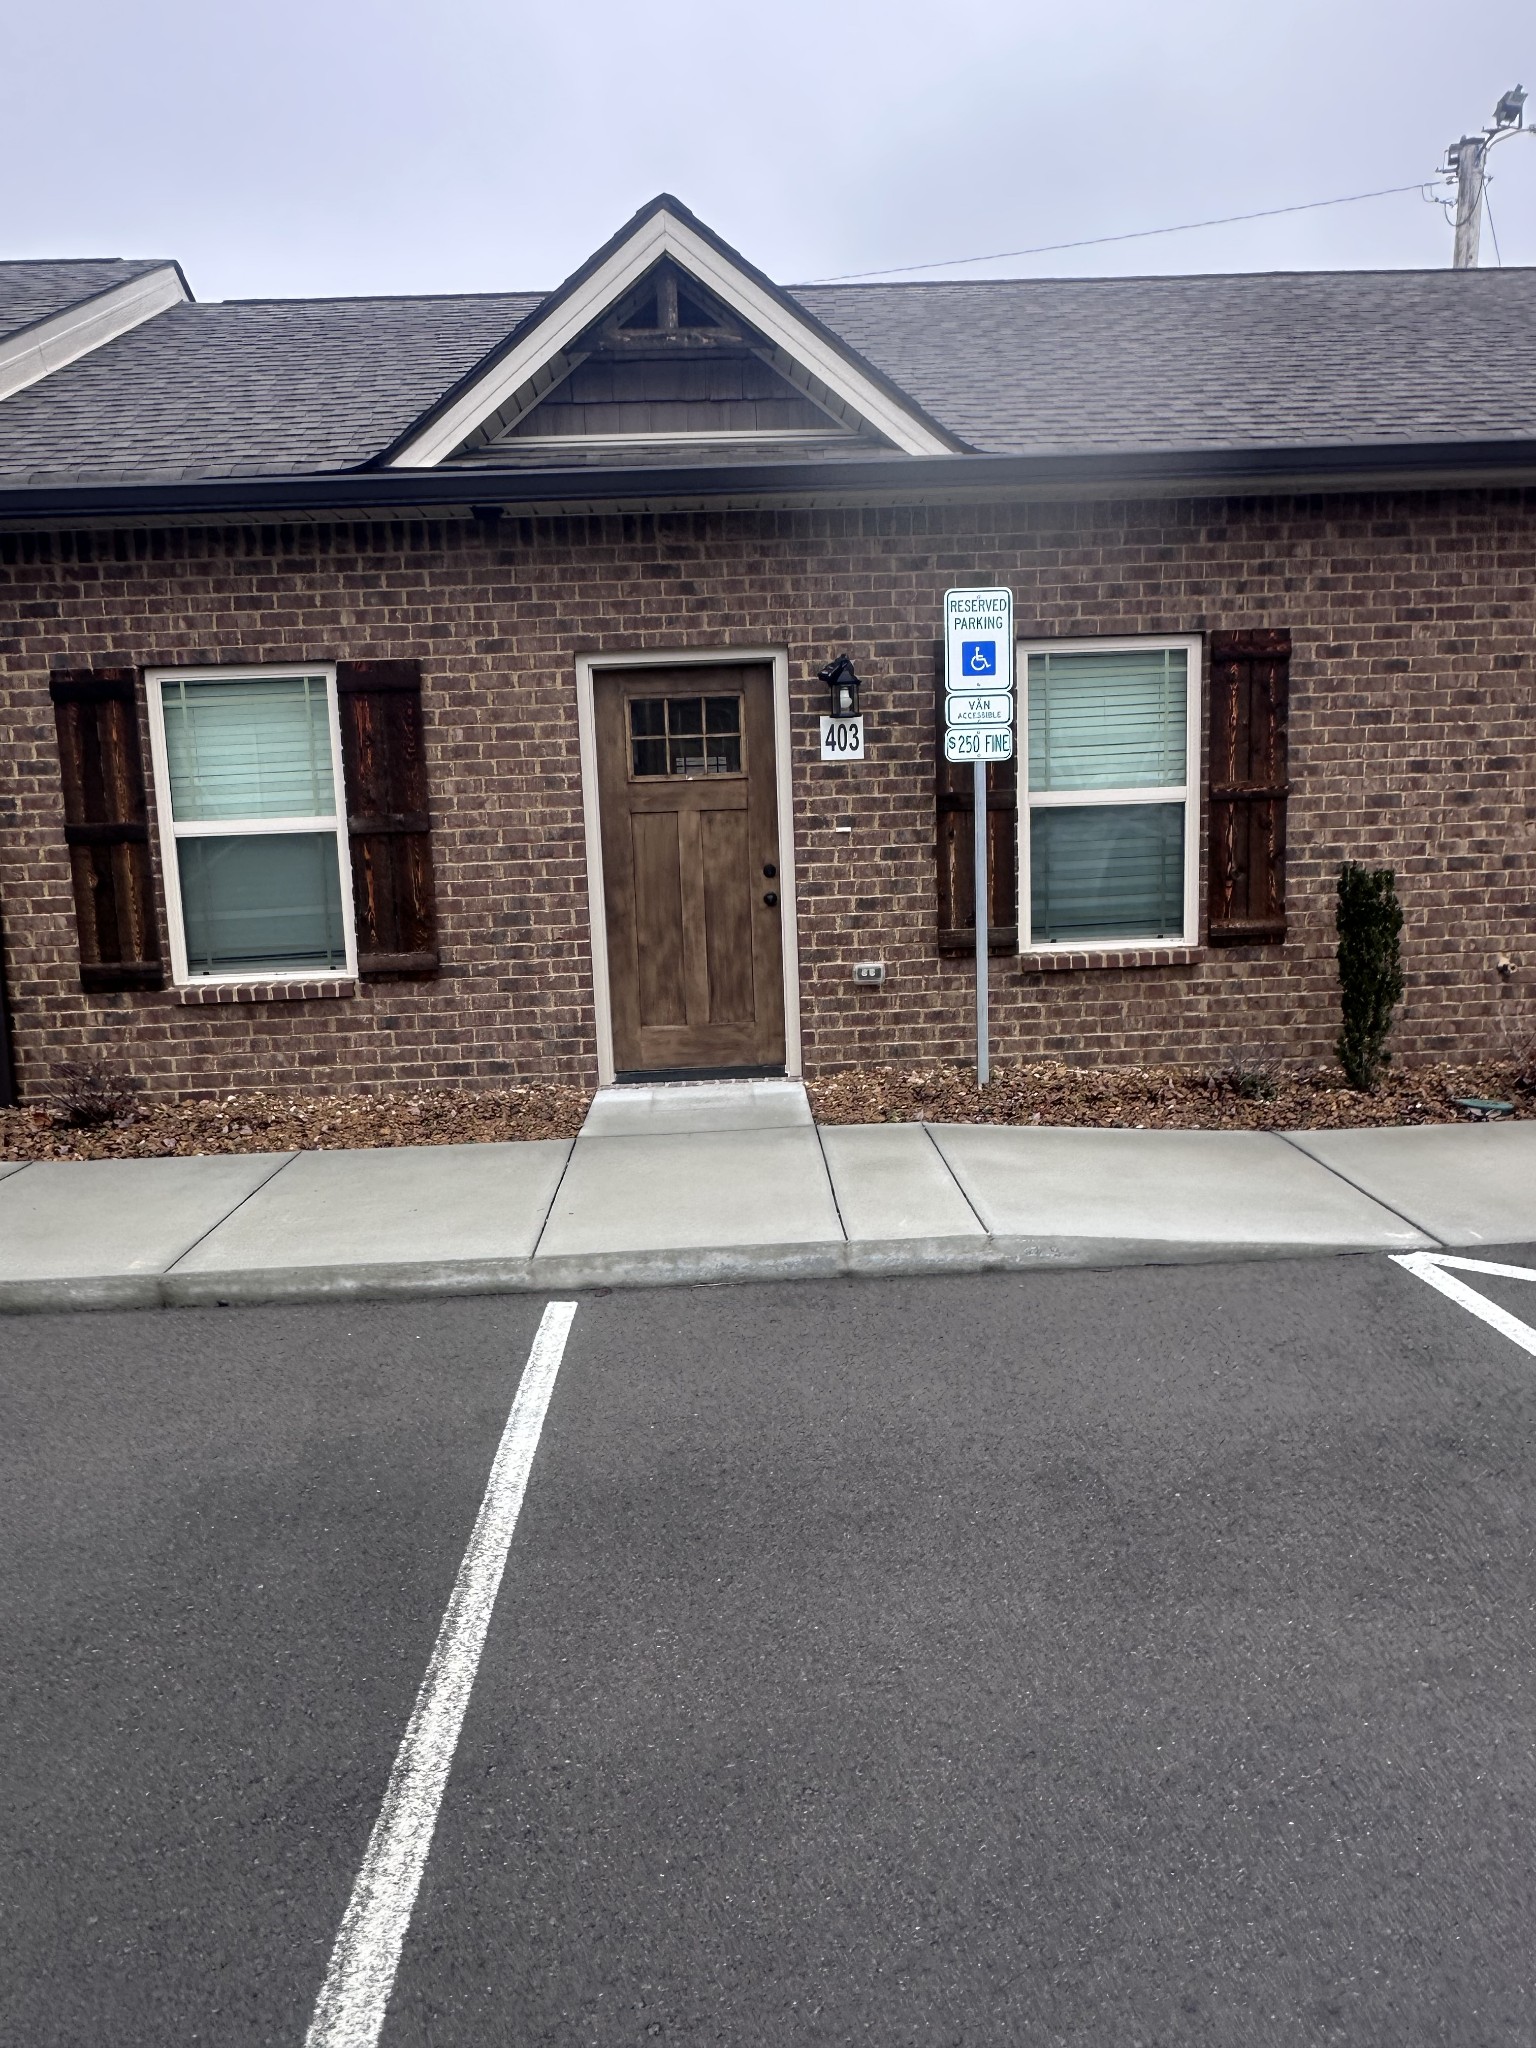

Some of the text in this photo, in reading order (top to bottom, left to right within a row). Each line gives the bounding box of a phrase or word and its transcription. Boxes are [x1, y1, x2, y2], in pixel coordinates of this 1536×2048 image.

[950, 598, 1007, 612] RESERVED
[954, 616, 1003, 630] PARKING
[968, 700, 990, 710] VAN
[957, 711, 1001, 719] ACCESSIBLE
[825, 723, 860, 751] 403
[948, 734, 1009, 753] $250 FINE
